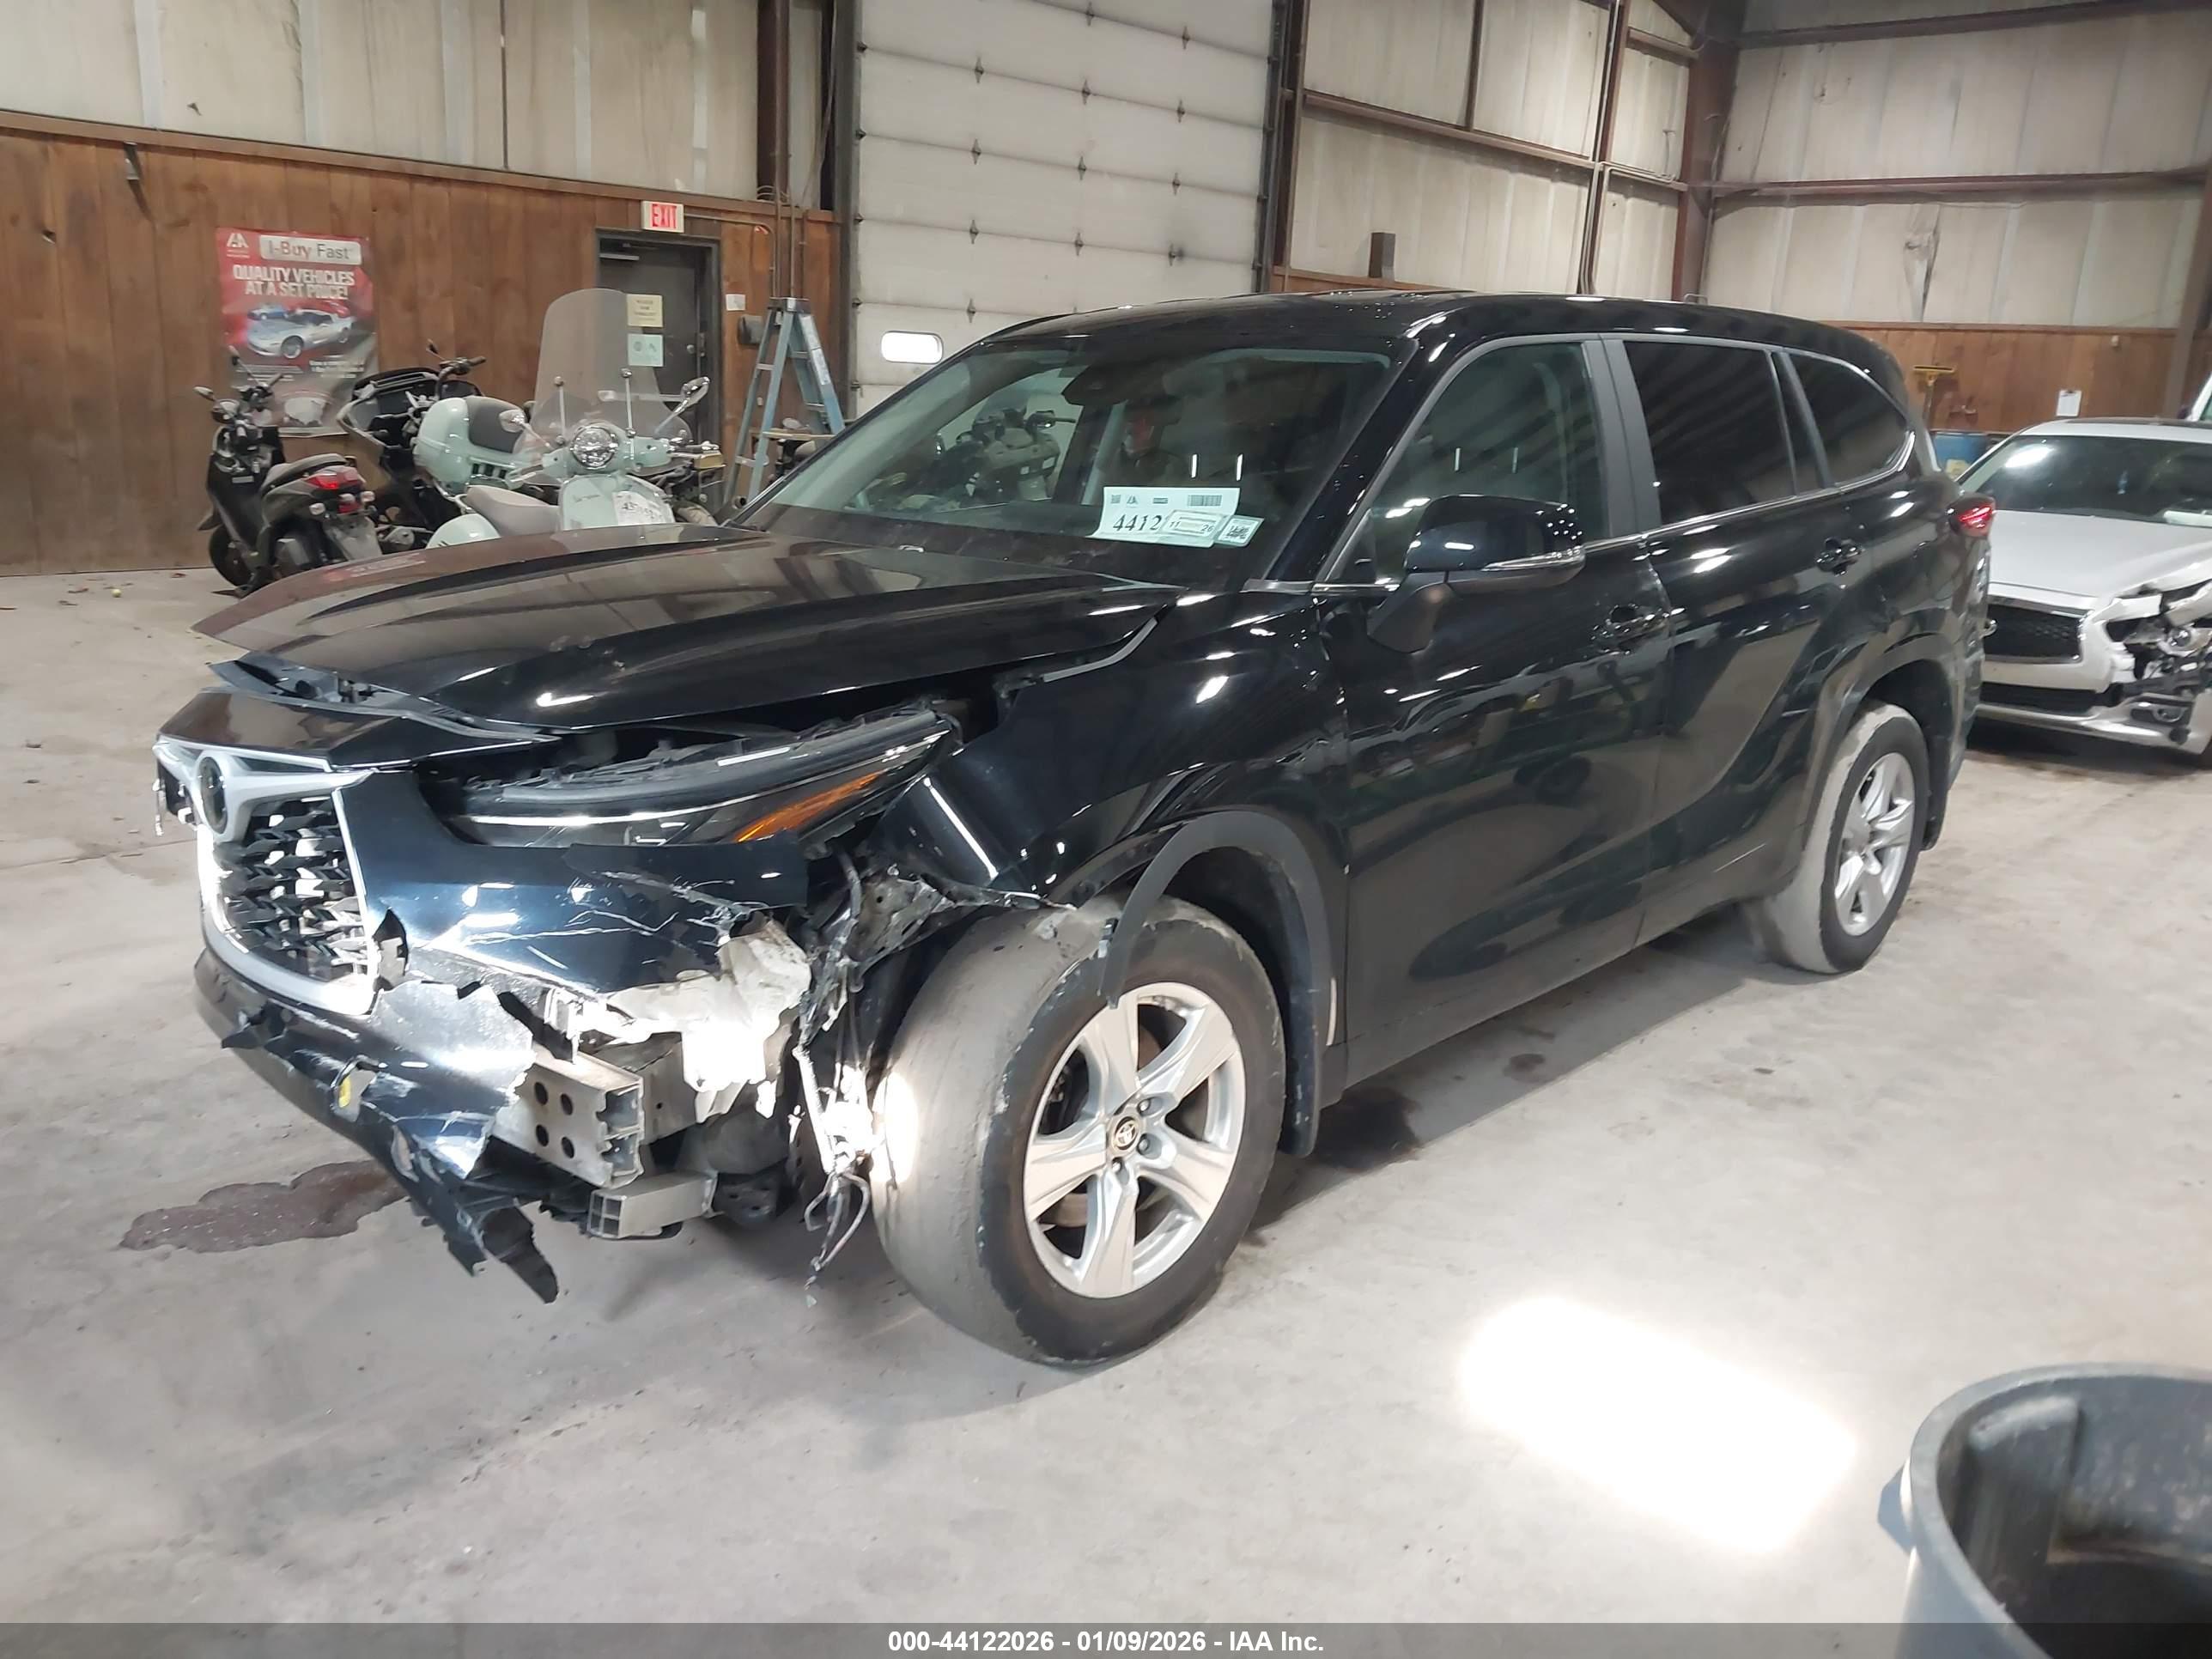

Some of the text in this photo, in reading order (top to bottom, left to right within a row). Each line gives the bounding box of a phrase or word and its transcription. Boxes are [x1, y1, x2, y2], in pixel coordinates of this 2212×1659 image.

[651, 203, 678, 229] EXIT
[317, 243, 349, 260] Fast
[233, 264, 356, 286] QUALITY VEHICLES
[245, 281, 349, 300] AT A SET PRICE!
[1201, 523, 1213, 532] 26
